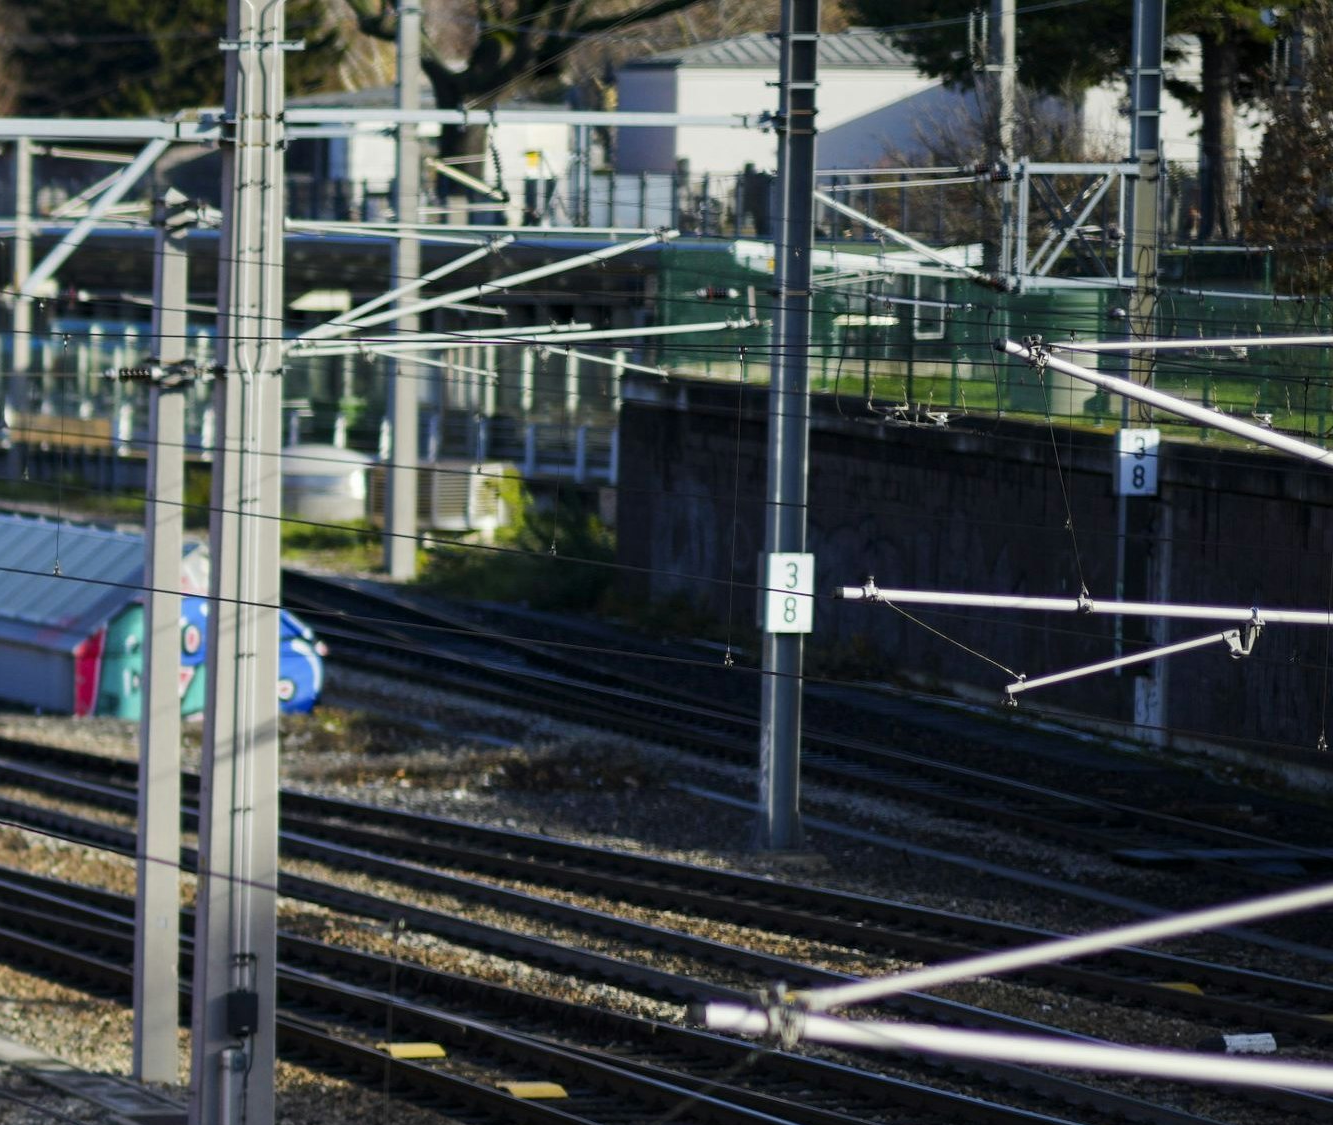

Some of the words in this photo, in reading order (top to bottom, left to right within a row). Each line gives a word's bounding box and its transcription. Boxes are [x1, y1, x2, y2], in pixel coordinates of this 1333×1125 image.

[1134, 436, 1145, 460] 3
[1132, 464, 1145, 489] 8
[785, 562, 798, 588] 3
[783, 596, 797, 623] 8
